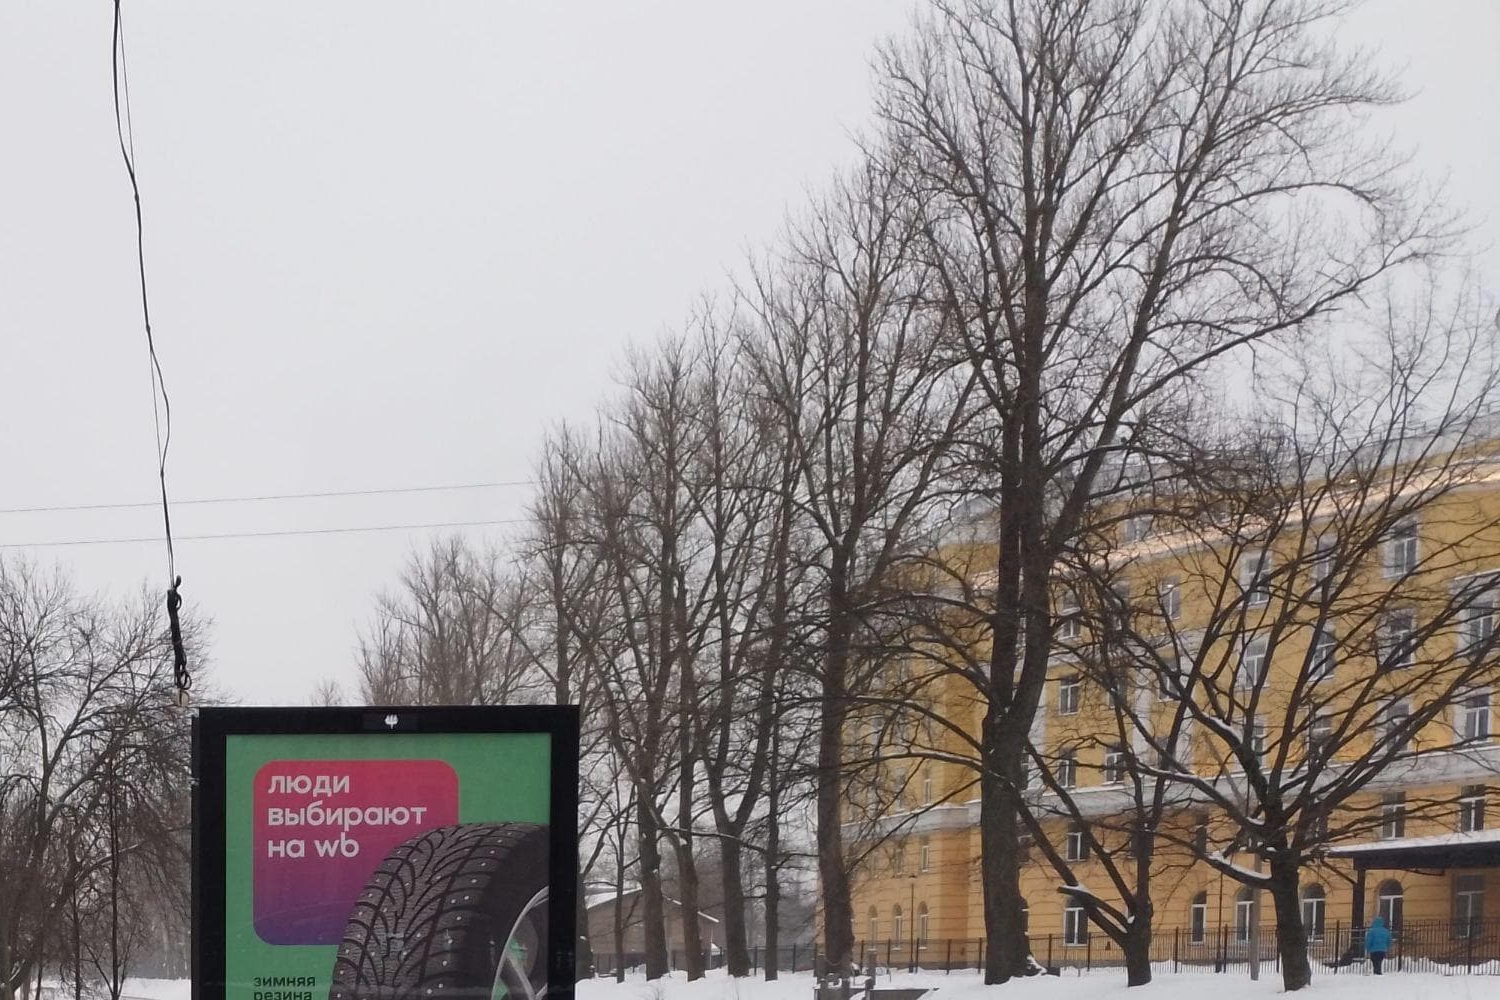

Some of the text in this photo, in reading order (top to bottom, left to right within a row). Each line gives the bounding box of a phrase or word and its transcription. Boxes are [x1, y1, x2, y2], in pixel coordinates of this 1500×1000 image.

[268, 775, 349, 797] люди
[268, 800, 427, 831] выбирают
[268, 832, 359, 858] на wb
[253, 976, 316, 987] зимняя
